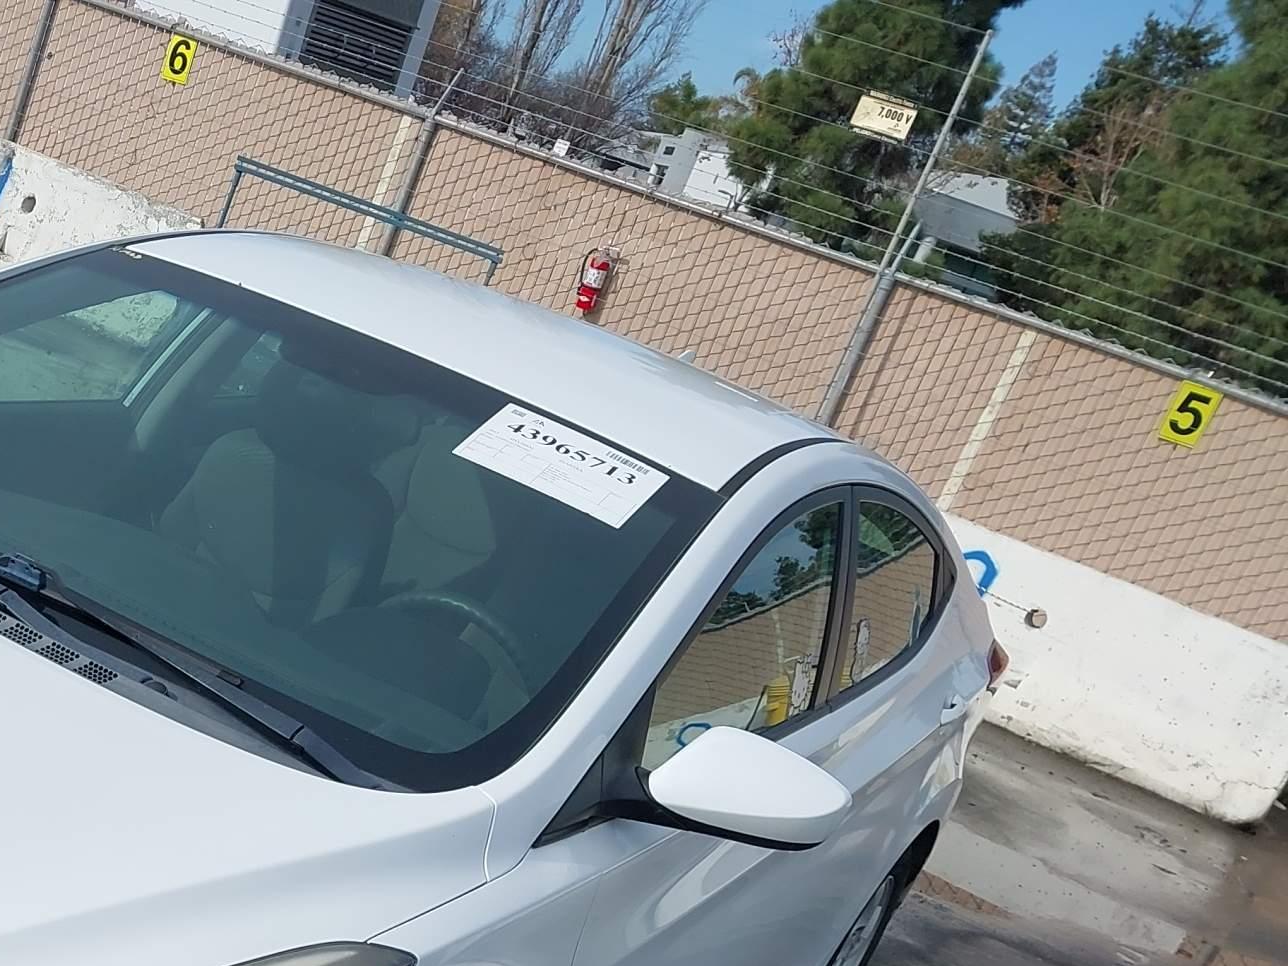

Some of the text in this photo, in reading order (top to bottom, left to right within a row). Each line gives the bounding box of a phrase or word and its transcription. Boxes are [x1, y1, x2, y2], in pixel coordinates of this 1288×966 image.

[169, 39, 191, 75] 6
[877, 106, 905, 123] 7,000
[905, 113, 913, 125] V
[1169, 391, 1213, 435] 5
[507, 423, 638, 486] 43965713
